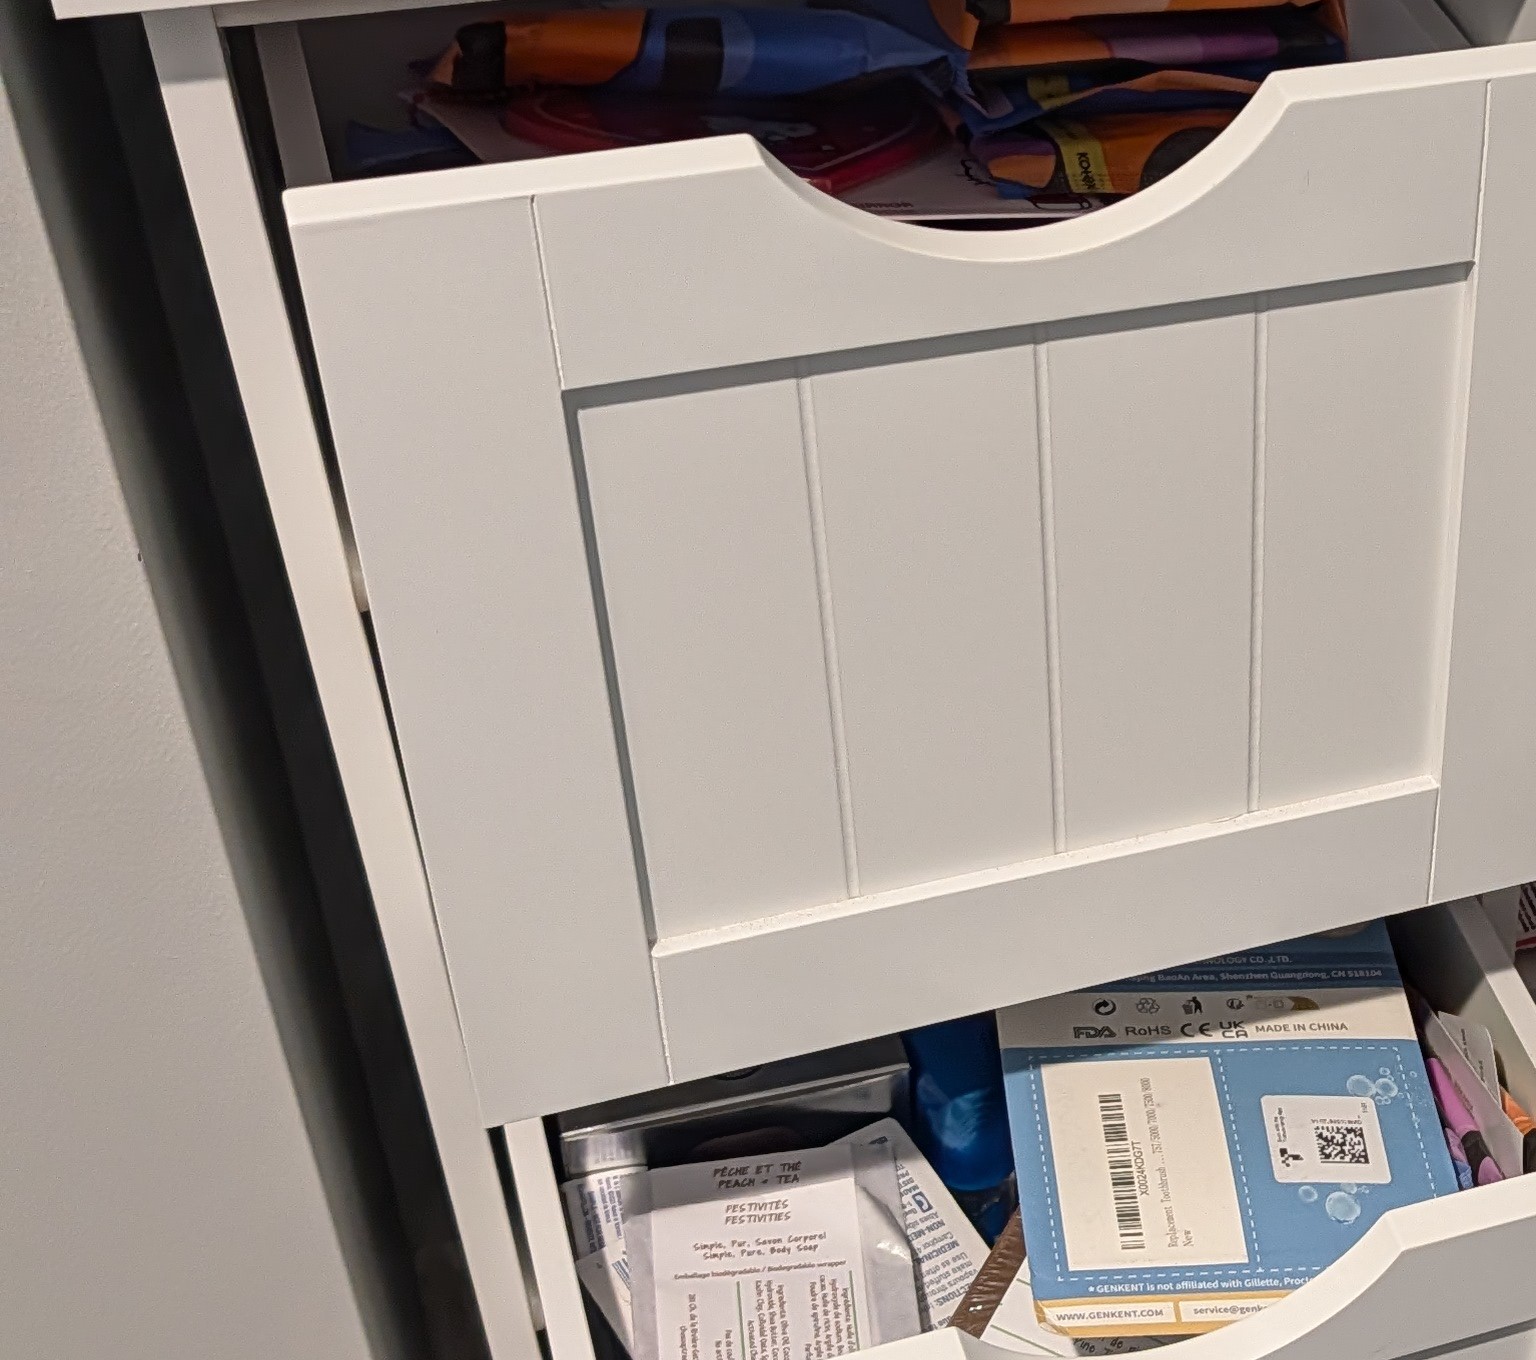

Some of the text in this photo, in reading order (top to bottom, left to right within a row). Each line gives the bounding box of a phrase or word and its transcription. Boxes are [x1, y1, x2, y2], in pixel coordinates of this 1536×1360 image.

[1220, 972, 1269, 980] Shenzhen
[1073, 1026, 1117, 1039] FDA
[1126, 1025, 1172, 1037] RoHS
[1219, 1021, 1245, 1031] UK
[1255, 1023, 1290, 1033] MADE
[1293, 1022, 1307, 1032] IN
[1309, 1021, 1349, 1032] CHINA
[755, 1164, 774, 1175] ET
[1131, 1141, 1150, 1196] X0024KDG7T
[718, 1173, 800, 1189] PEACH TEA
[724, 1211, 791, 1226] FESTIVITIES
[1166, 1206, 1179, 1248] Replacement
[755, 1231, 826, 1246] Savon Corporel
[1183, 1229, 1195, 1247] New
[770, 1246, 791, 1255] Body
[950, 1251, 968, 1265] Use
[767, 1262, 816, 1272] Biodegradable
[817, 1260, 847, 1269] wrapper
[940, 1259, 951, 1269] as
[951, 1259, 973, 1275] make
[946, 1266, 979, 1288] vapours
[1097, 1283, 1145, 1293] GENKENT
[1147, 1283, 1154, 1291] is
[1157, 1282, 1173, 1291] not
[1175, 1279, 1219, 1290] affiliated
[1221, 1279, 1242, 1289] with
[1244, 1277, 1283, 1288] Gillette,
[1056, 1309, 1164, 1321] WWW.GENKENT.COM
